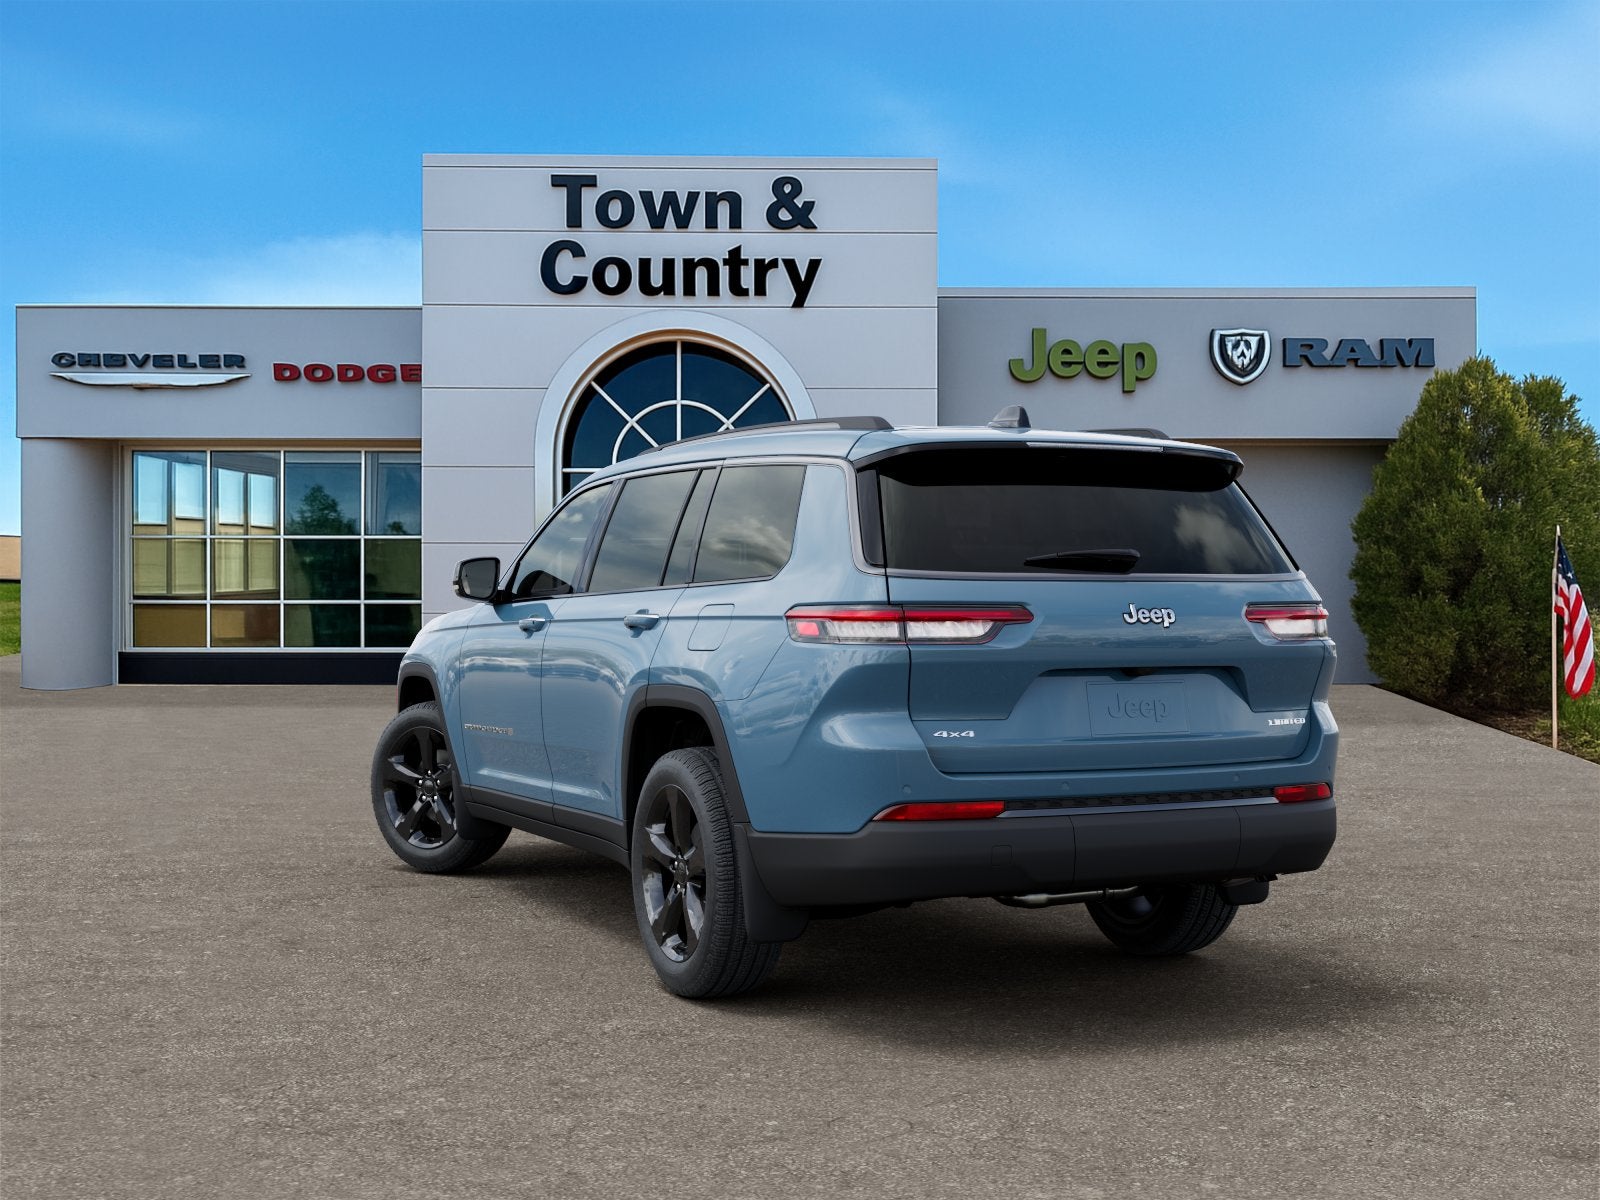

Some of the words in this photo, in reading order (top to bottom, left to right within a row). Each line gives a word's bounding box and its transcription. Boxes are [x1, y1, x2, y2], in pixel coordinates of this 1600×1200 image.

[551, 174, 742, 229] Town
[765, 176, 818, 230] &
[540, 240, 822, 308] Country
[1009, 328, 1157, 392] Jeep
[1282, 337, 1436, 368] RAM
[273, 363, 422, 383] DODGE
[1122, 602, 1176, 628] Jeep
[1107, 691, 1167, 723] Jeep
[933, 730, 975, 738] 4x4
